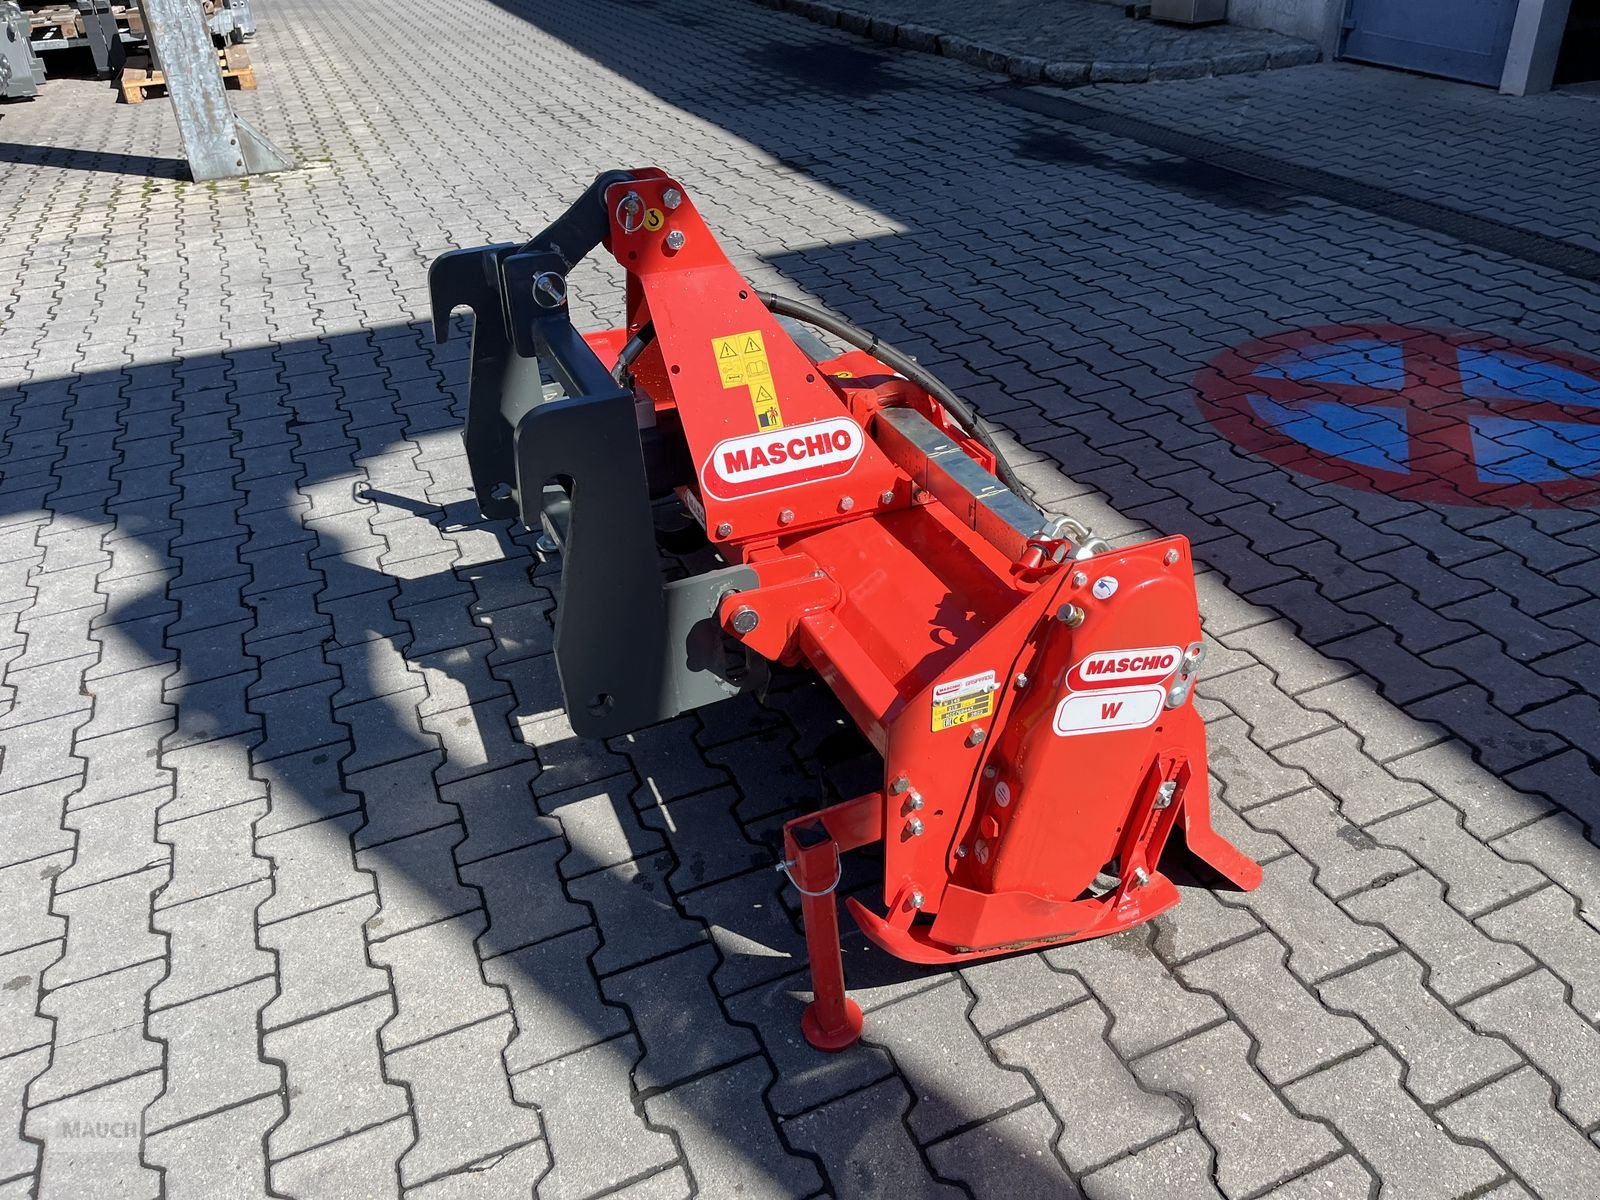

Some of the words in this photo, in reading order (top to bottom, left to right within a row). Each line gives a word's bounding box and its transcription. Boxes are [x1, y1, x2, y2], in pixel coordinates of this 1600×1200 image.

[723, 429, 851, 474] MASCHIO
[1086, 654, 1174, 675] MASCHIO
[1101, 702, 1123, 719] W
